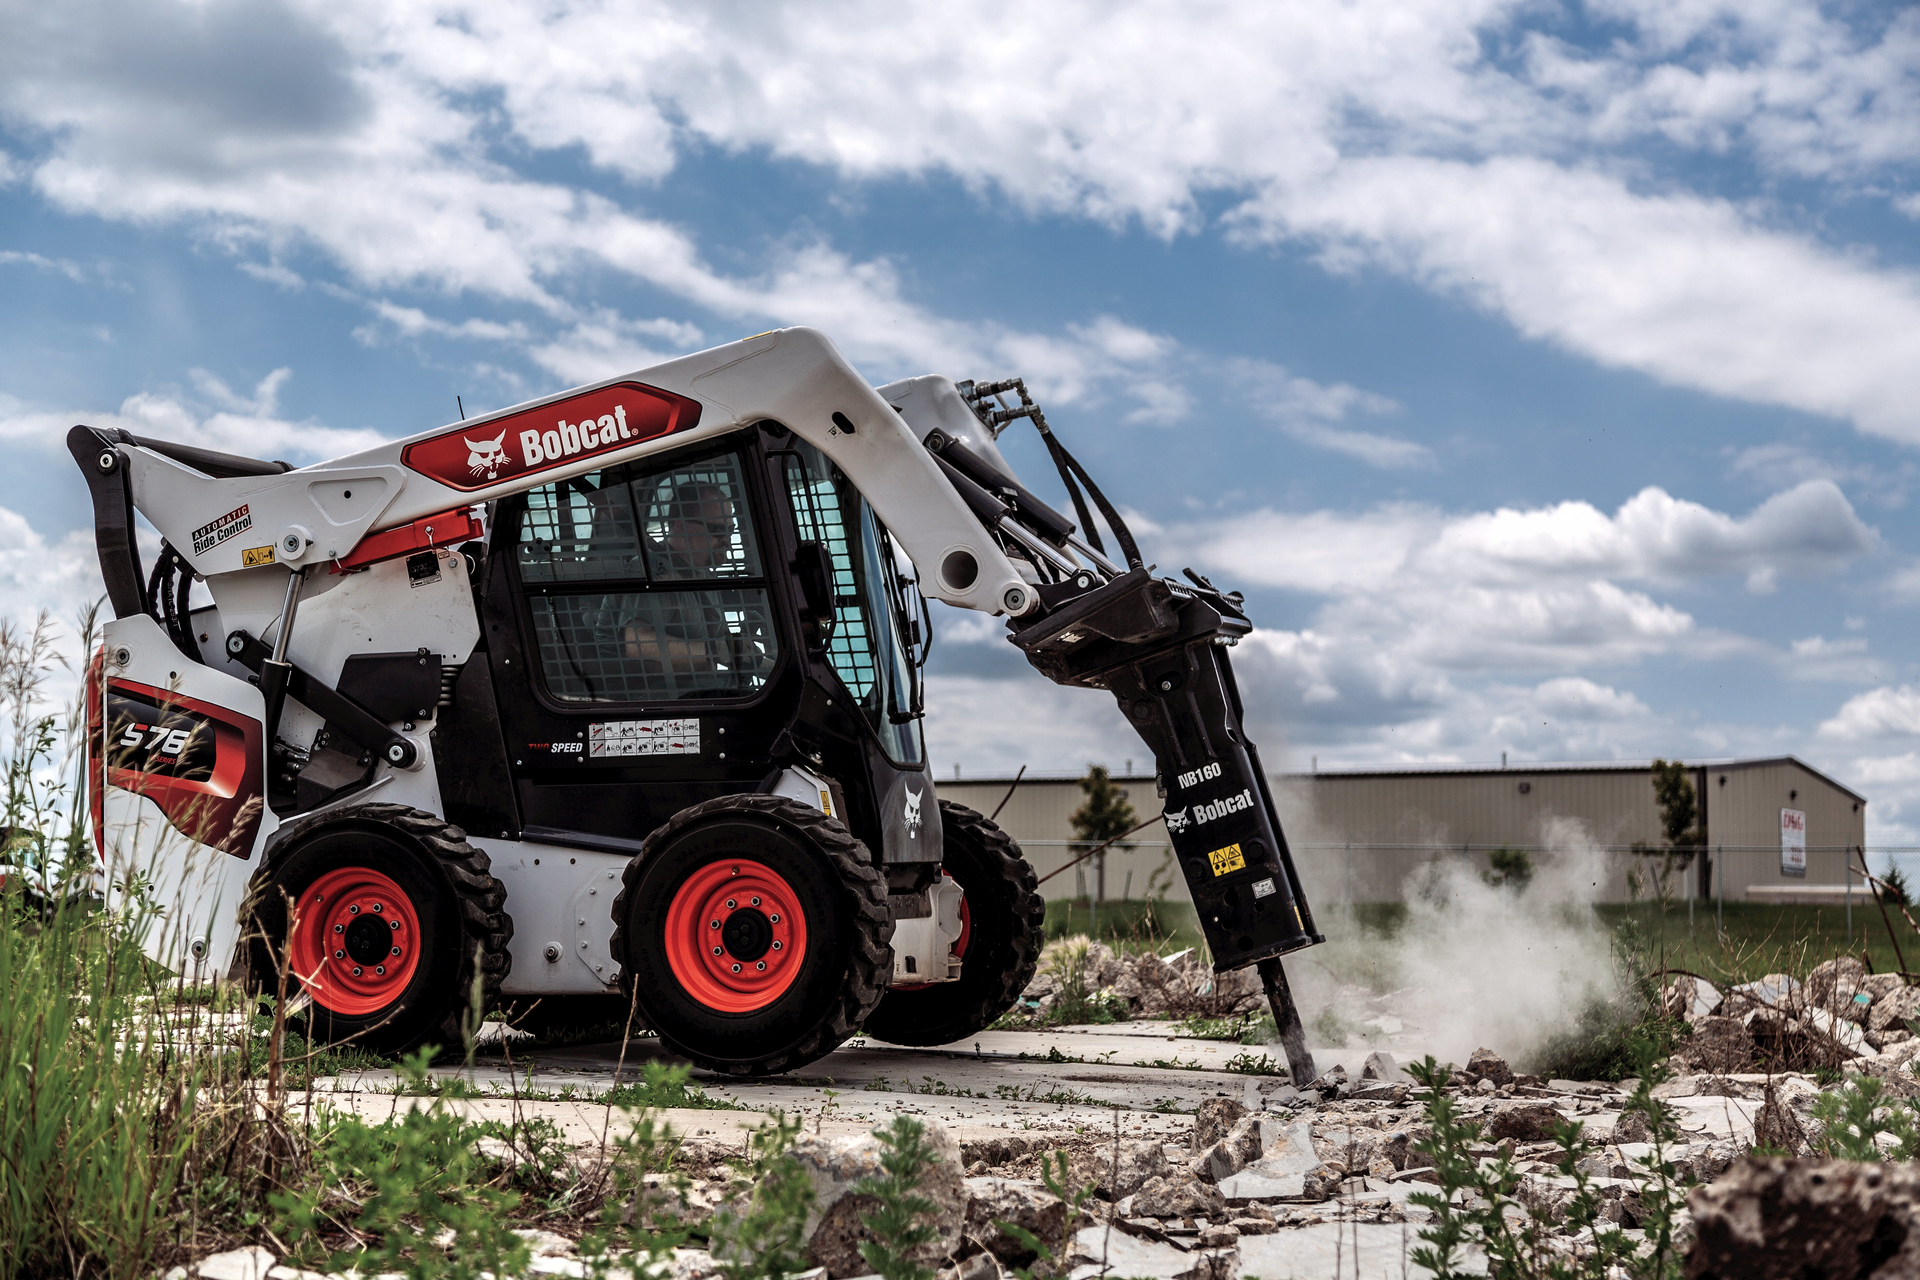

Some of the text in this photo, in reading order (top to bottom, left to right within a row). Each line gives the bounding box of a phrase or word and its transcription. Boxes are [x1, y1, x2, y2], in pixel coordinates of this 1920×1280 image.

[519, 405, 631, 467] Bobcat
[193, 505, 249, 541] AUTOMATIC
[193, 514, 252, 554] Ride Control
[120, 722, 191, 754] S76
[551, 742, 583, 753] SPEED
[1178, 762, 1222, 790] NB160
[1192, 788, 1254, 825] Bobcat
